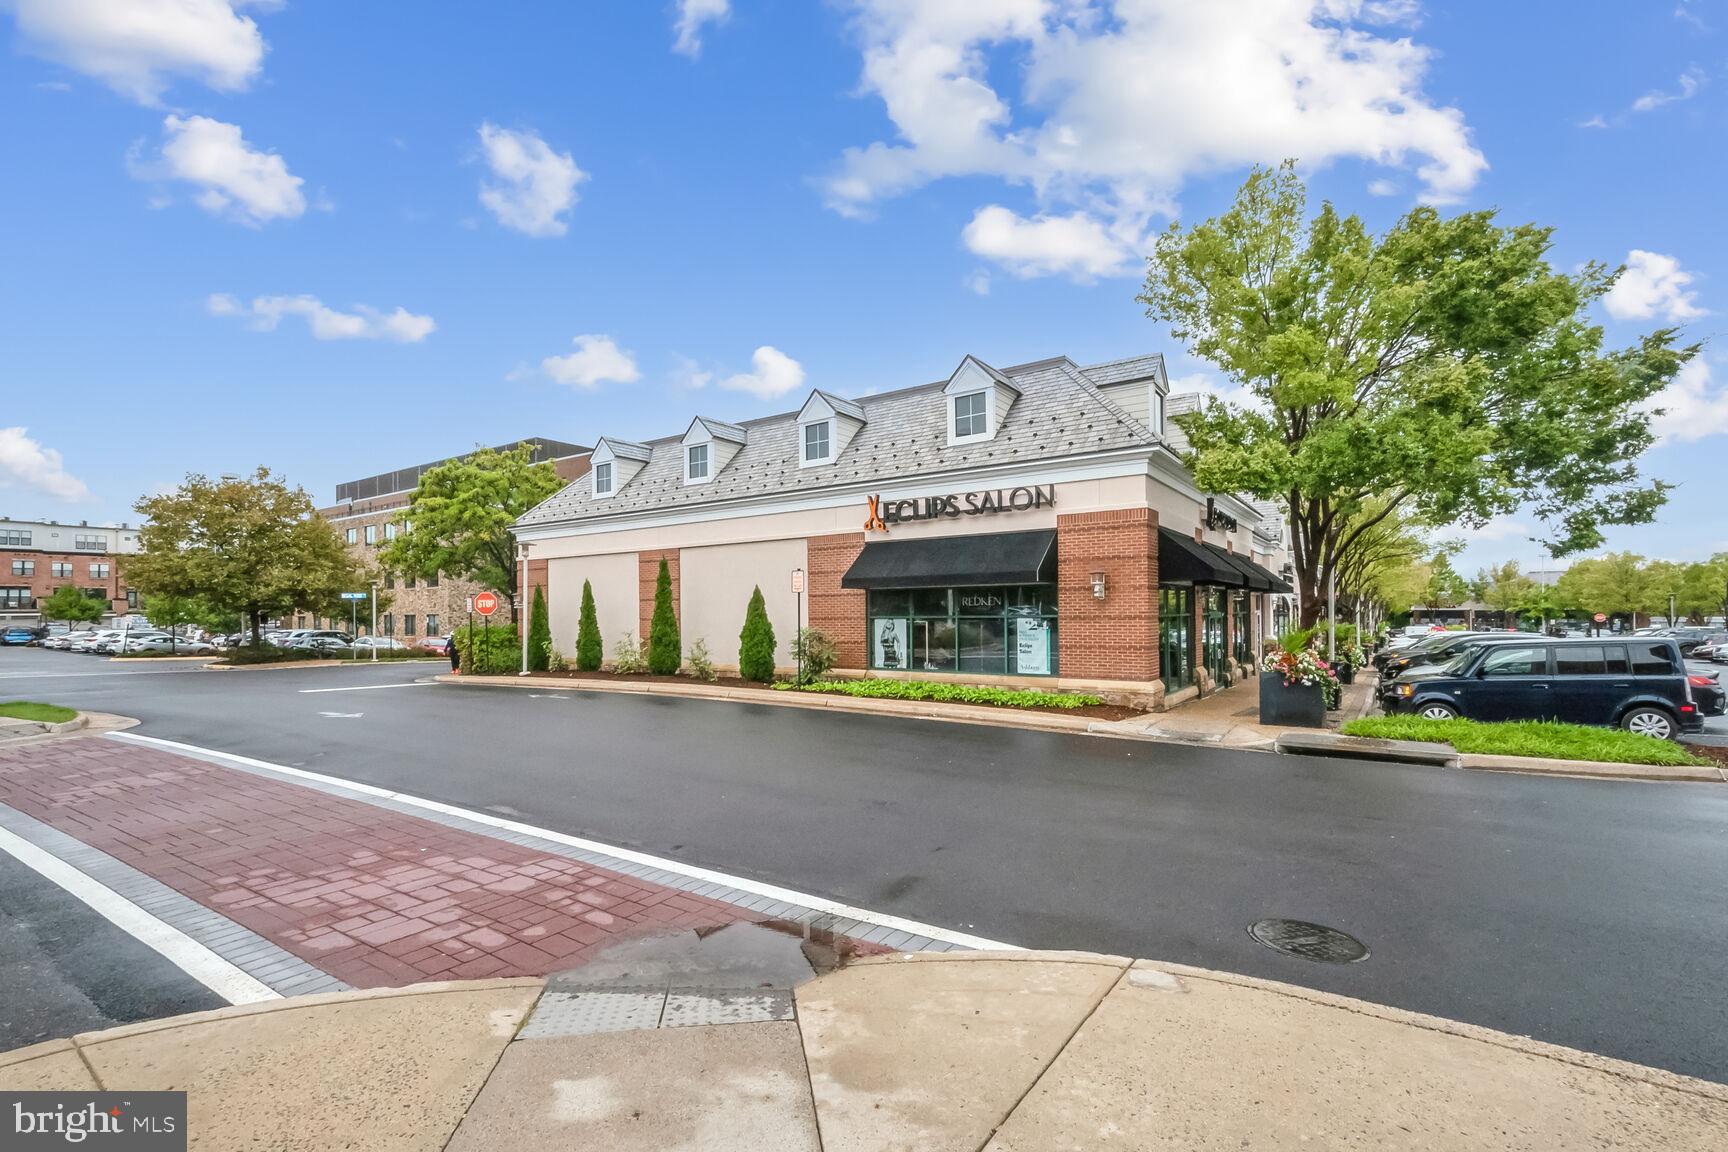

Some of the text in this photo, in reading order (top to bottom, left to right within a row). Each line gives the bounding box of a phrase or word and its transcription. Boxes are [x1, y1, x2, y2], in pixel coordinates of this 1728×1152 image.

[883, 484, 1056, 523] ECLIPS SALON
[478, 600, 494, 608] STOP
[962, 596, 1001, 606] REDKEN
